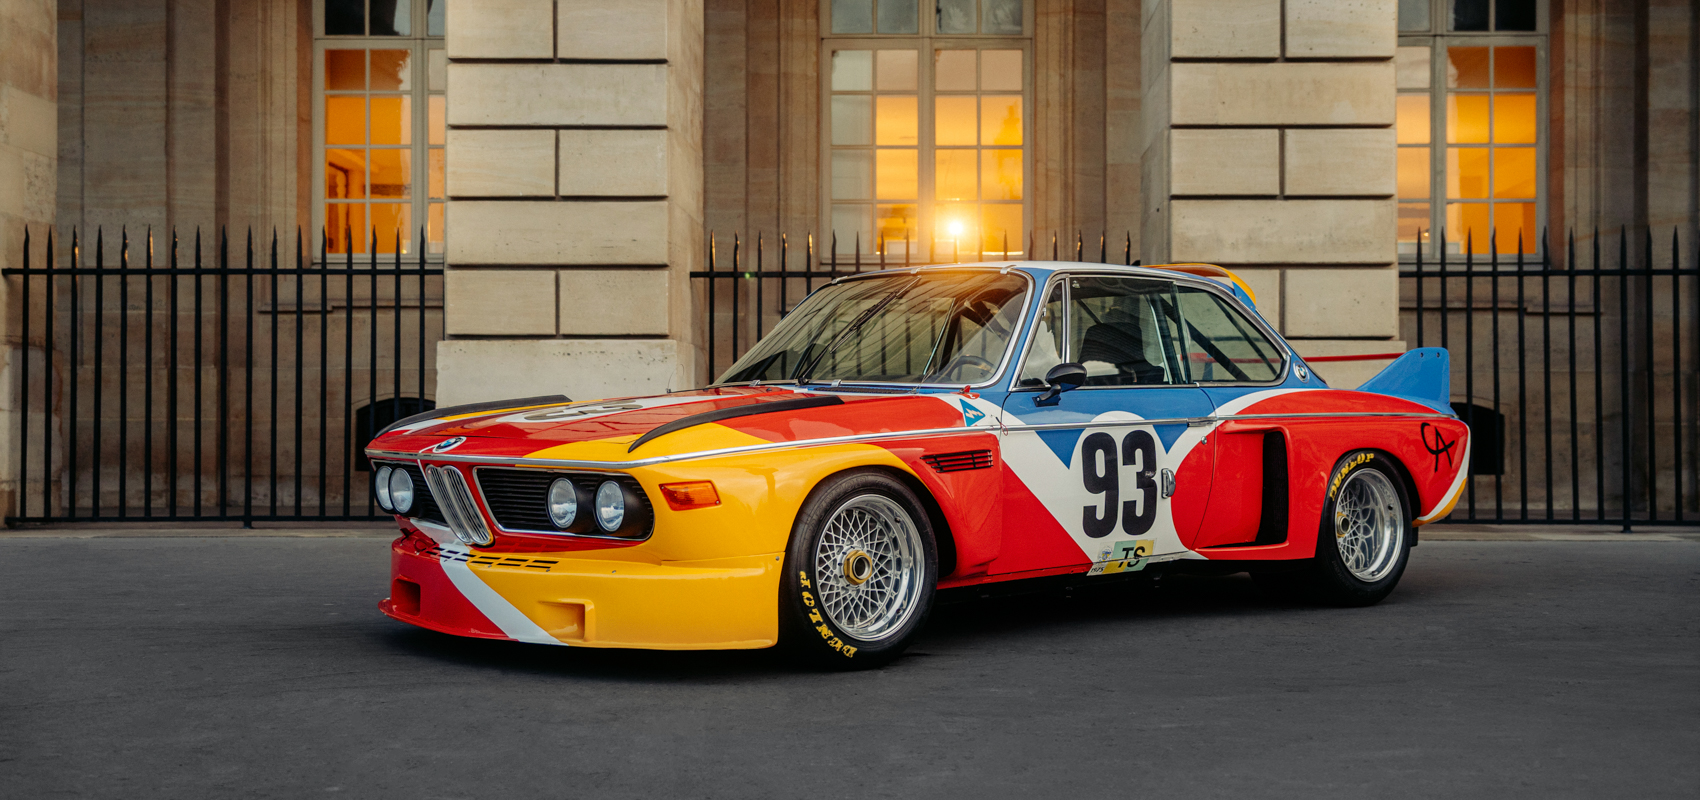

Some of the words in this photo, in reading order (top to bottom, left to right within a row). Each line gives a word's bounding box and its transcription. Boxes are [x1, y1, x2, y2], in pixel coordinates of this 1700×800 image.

[1081, 429, 1158, 538] 93
[1329, 453, 1374, 501] DUNLOP
[1118, 546, 1145, 568] TS
[799, 571, 857, 658] DUNLOP
